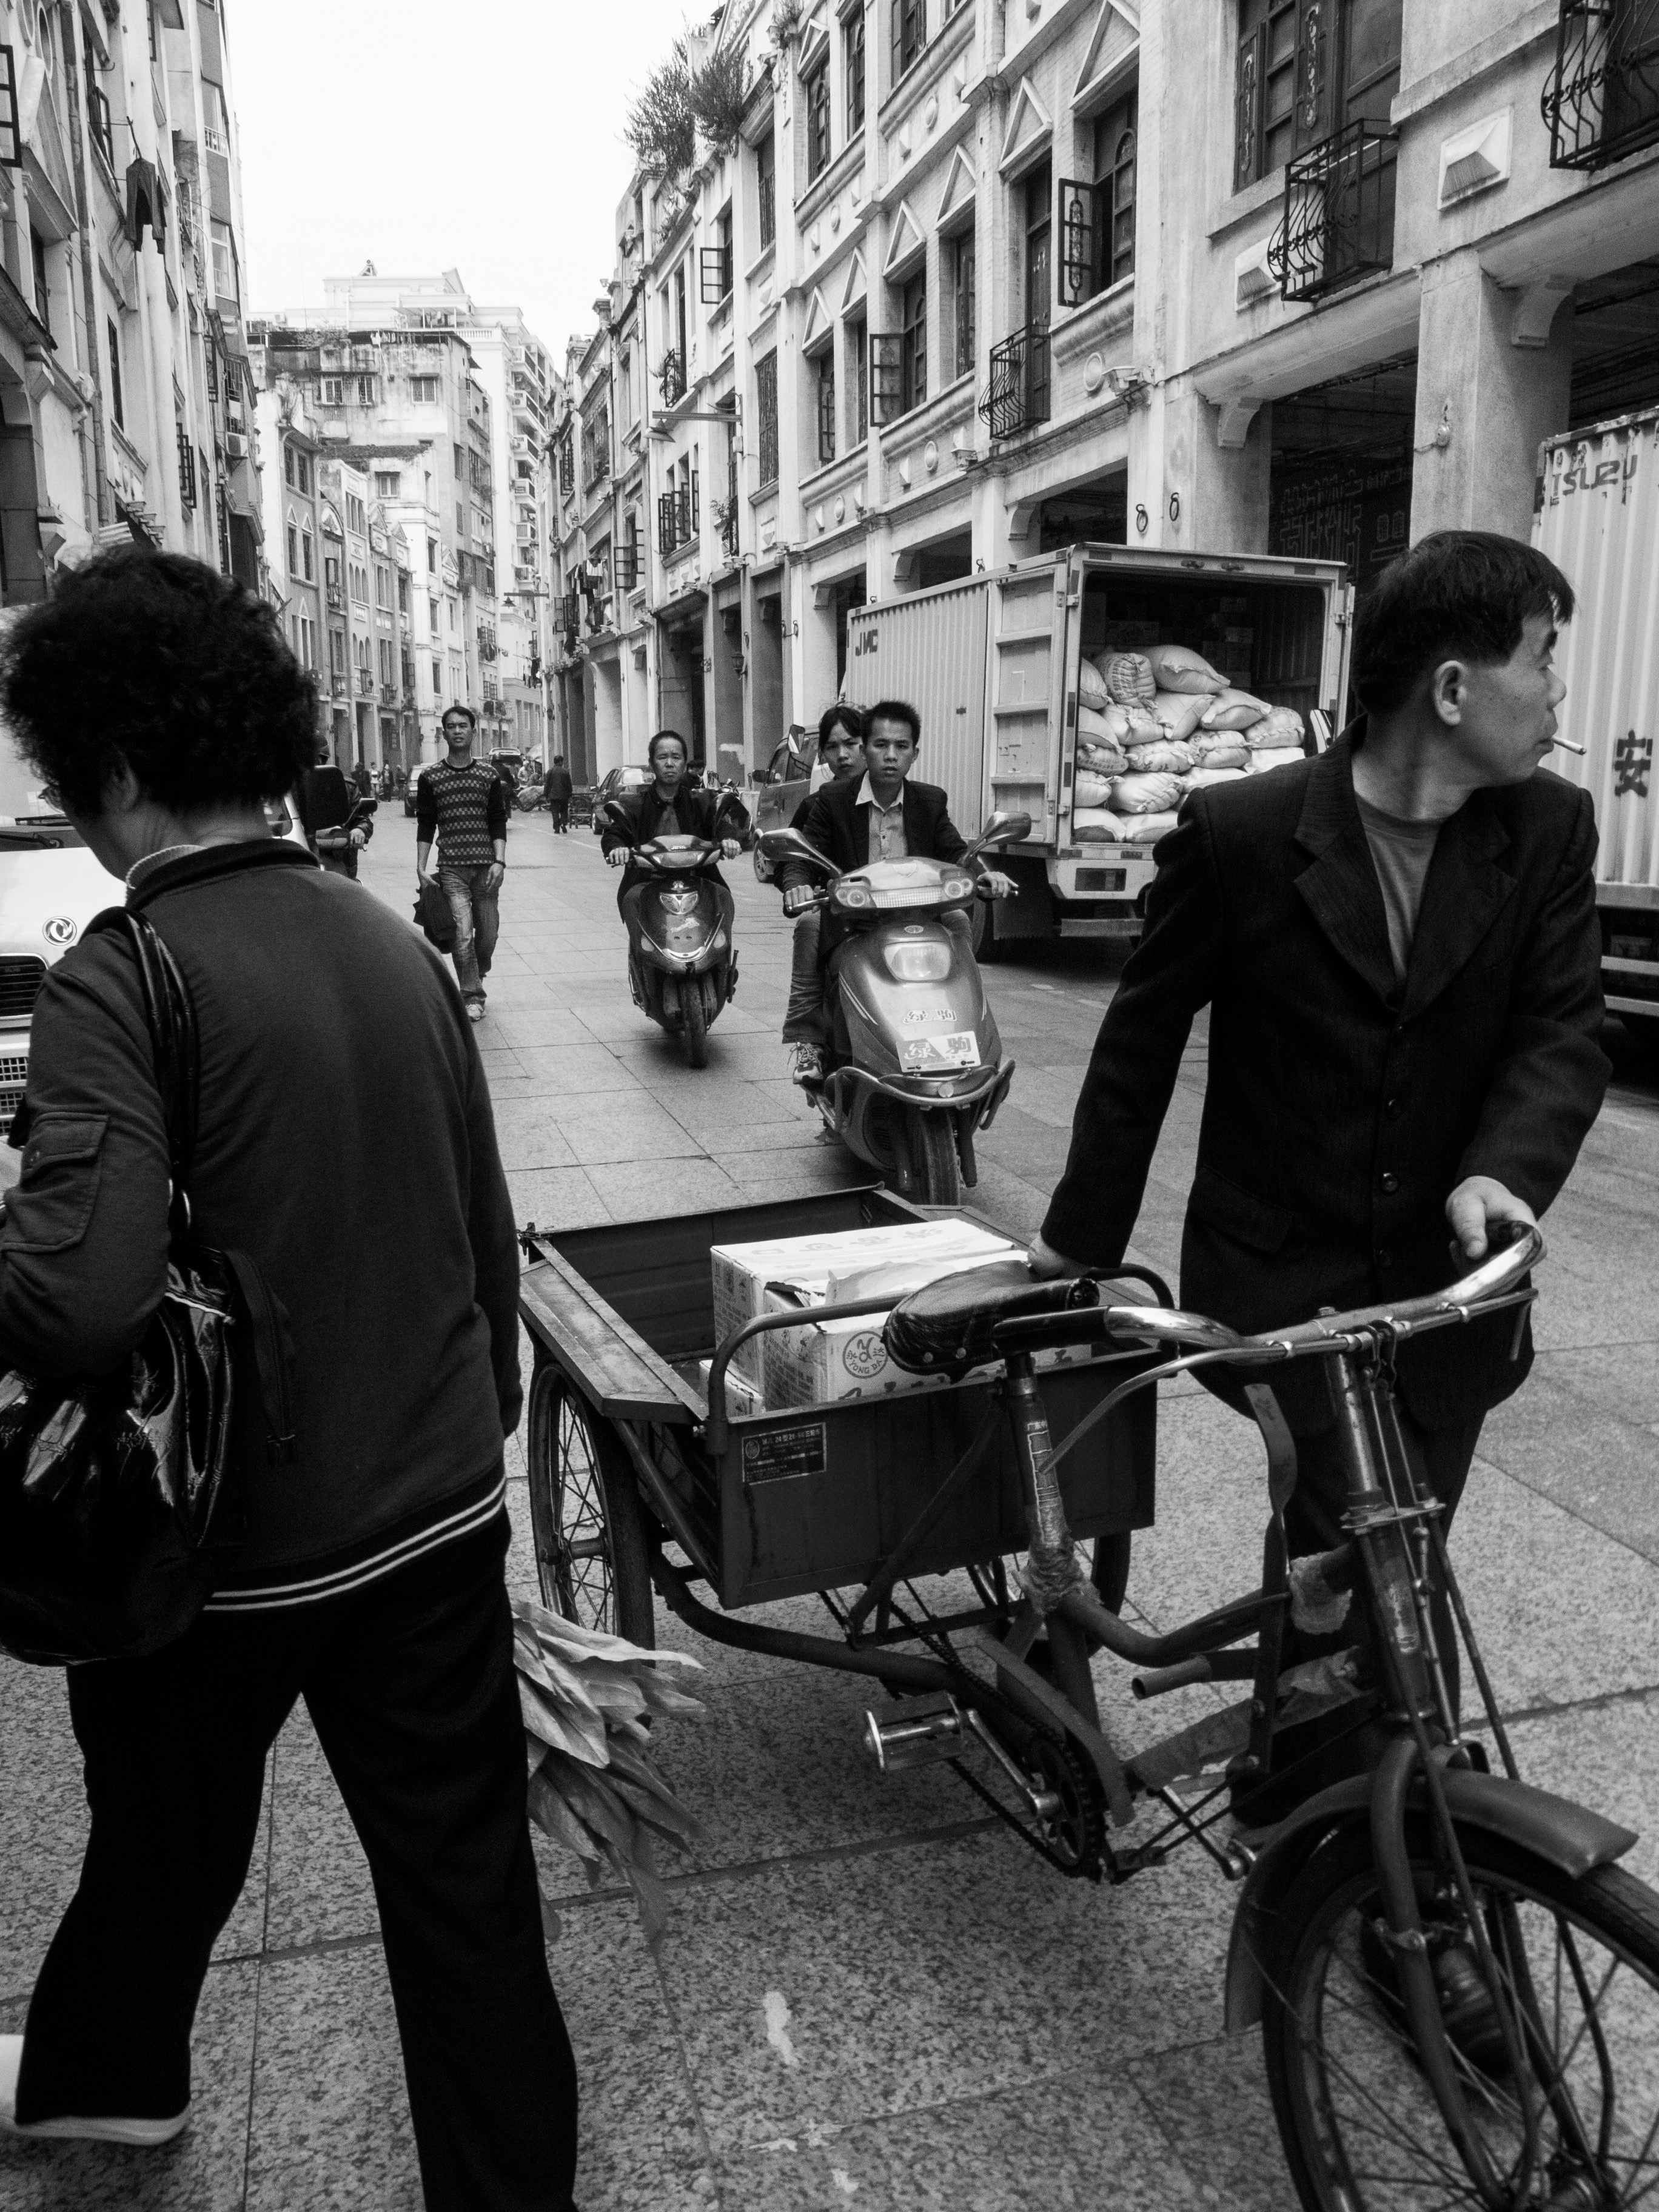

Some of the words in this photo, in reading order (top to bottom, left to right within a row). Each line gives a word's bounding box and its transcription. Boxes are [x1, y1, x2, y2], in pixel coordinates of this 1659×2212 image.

[1552, 455, 1638, 496] ISUZU
[855, 629, 878, 657] JMC
[1614, 728, 1653, 798] 安
[904, 1036, 972, 1060] 绿驹
[849, 1359, 870, 1374] YONG
[871, 1360, 882, 1370] DA
